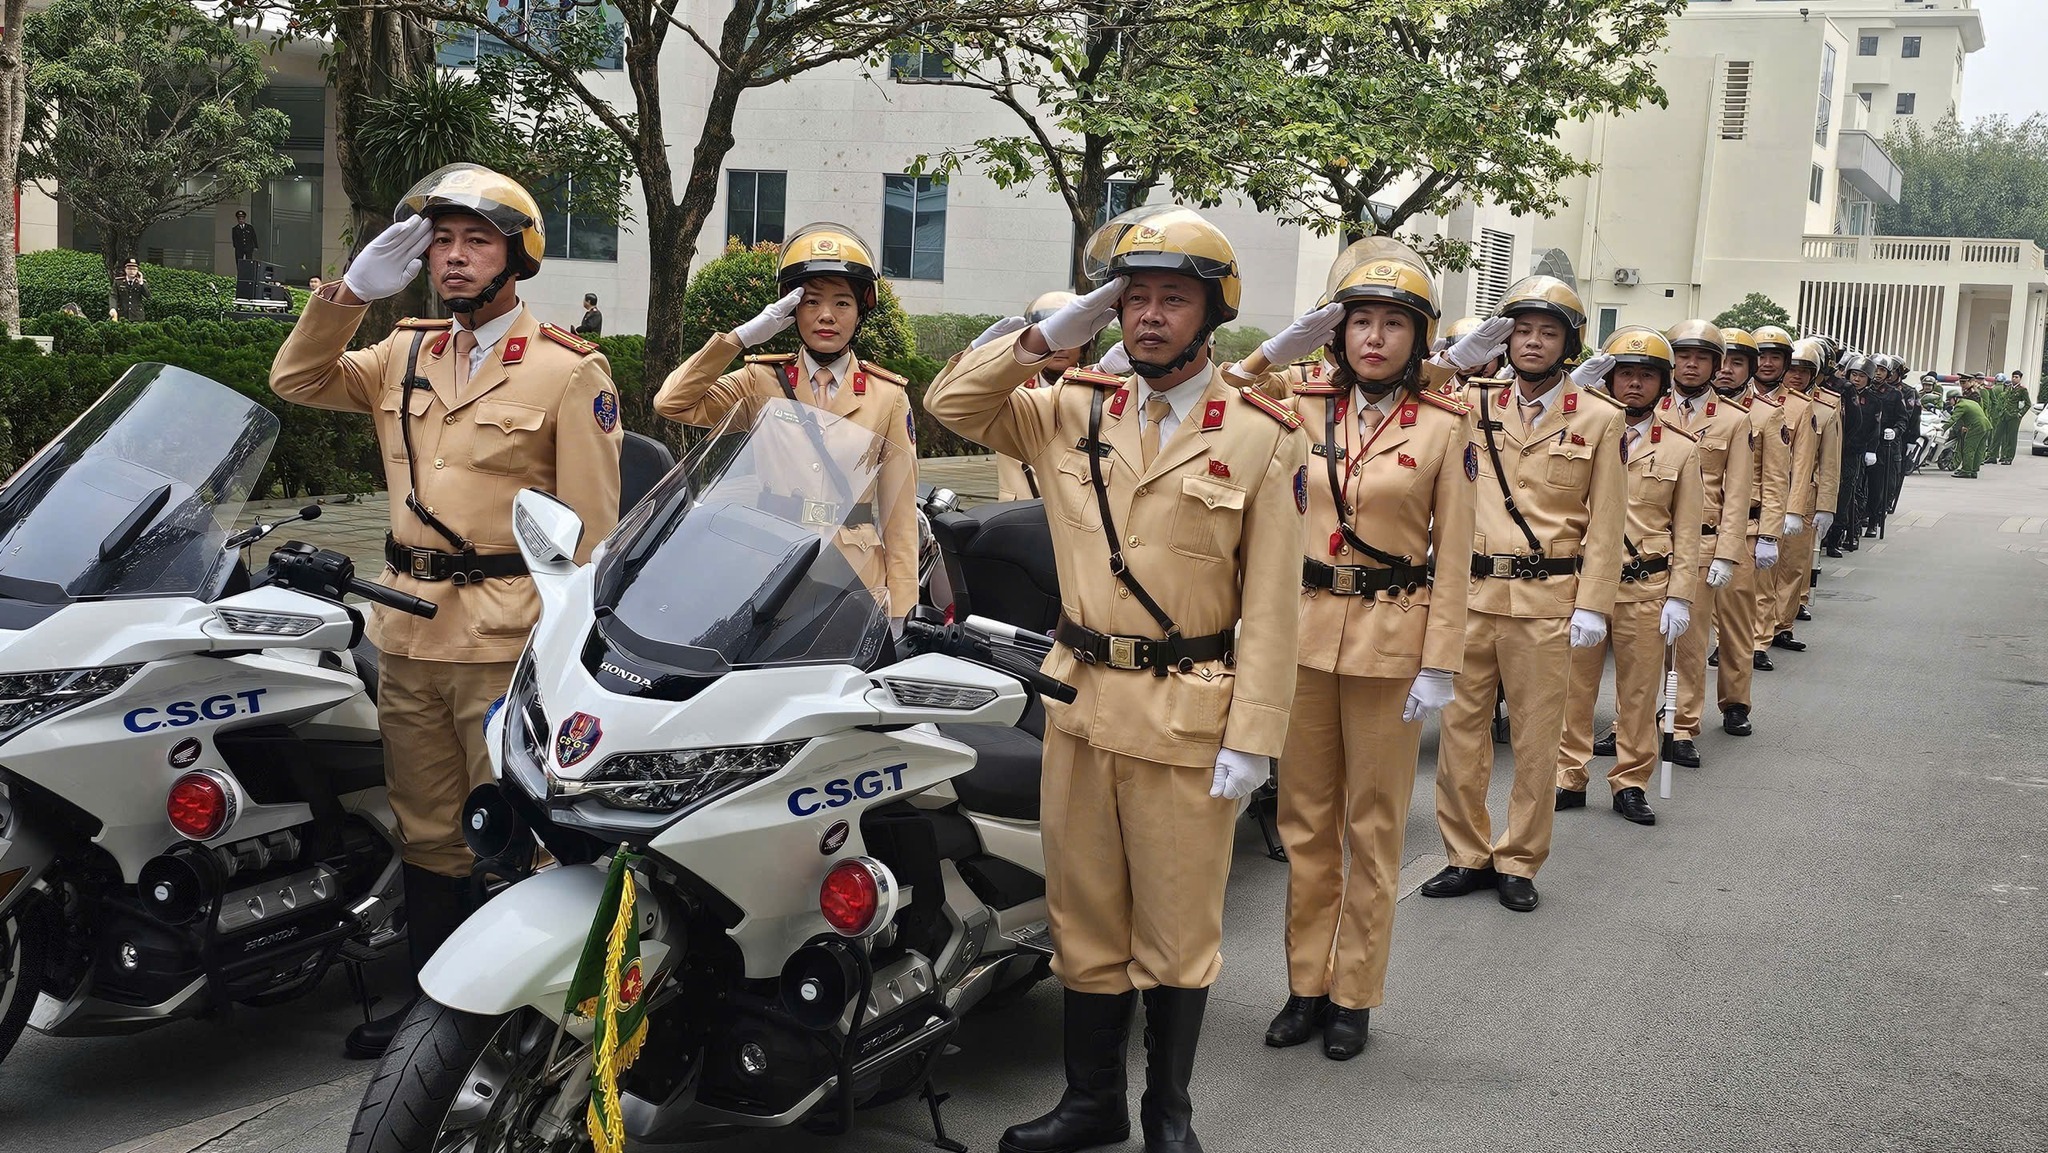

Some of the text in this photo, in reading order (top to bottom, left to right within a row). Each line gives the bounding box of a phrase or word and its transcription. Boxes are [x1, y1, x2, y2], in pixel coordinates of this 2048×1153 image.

[599, 661, 653, 689] HONDA
[123, 688, 267, 733] C.S.G.T
[787, 762, 908, 817] C.S.G.T
